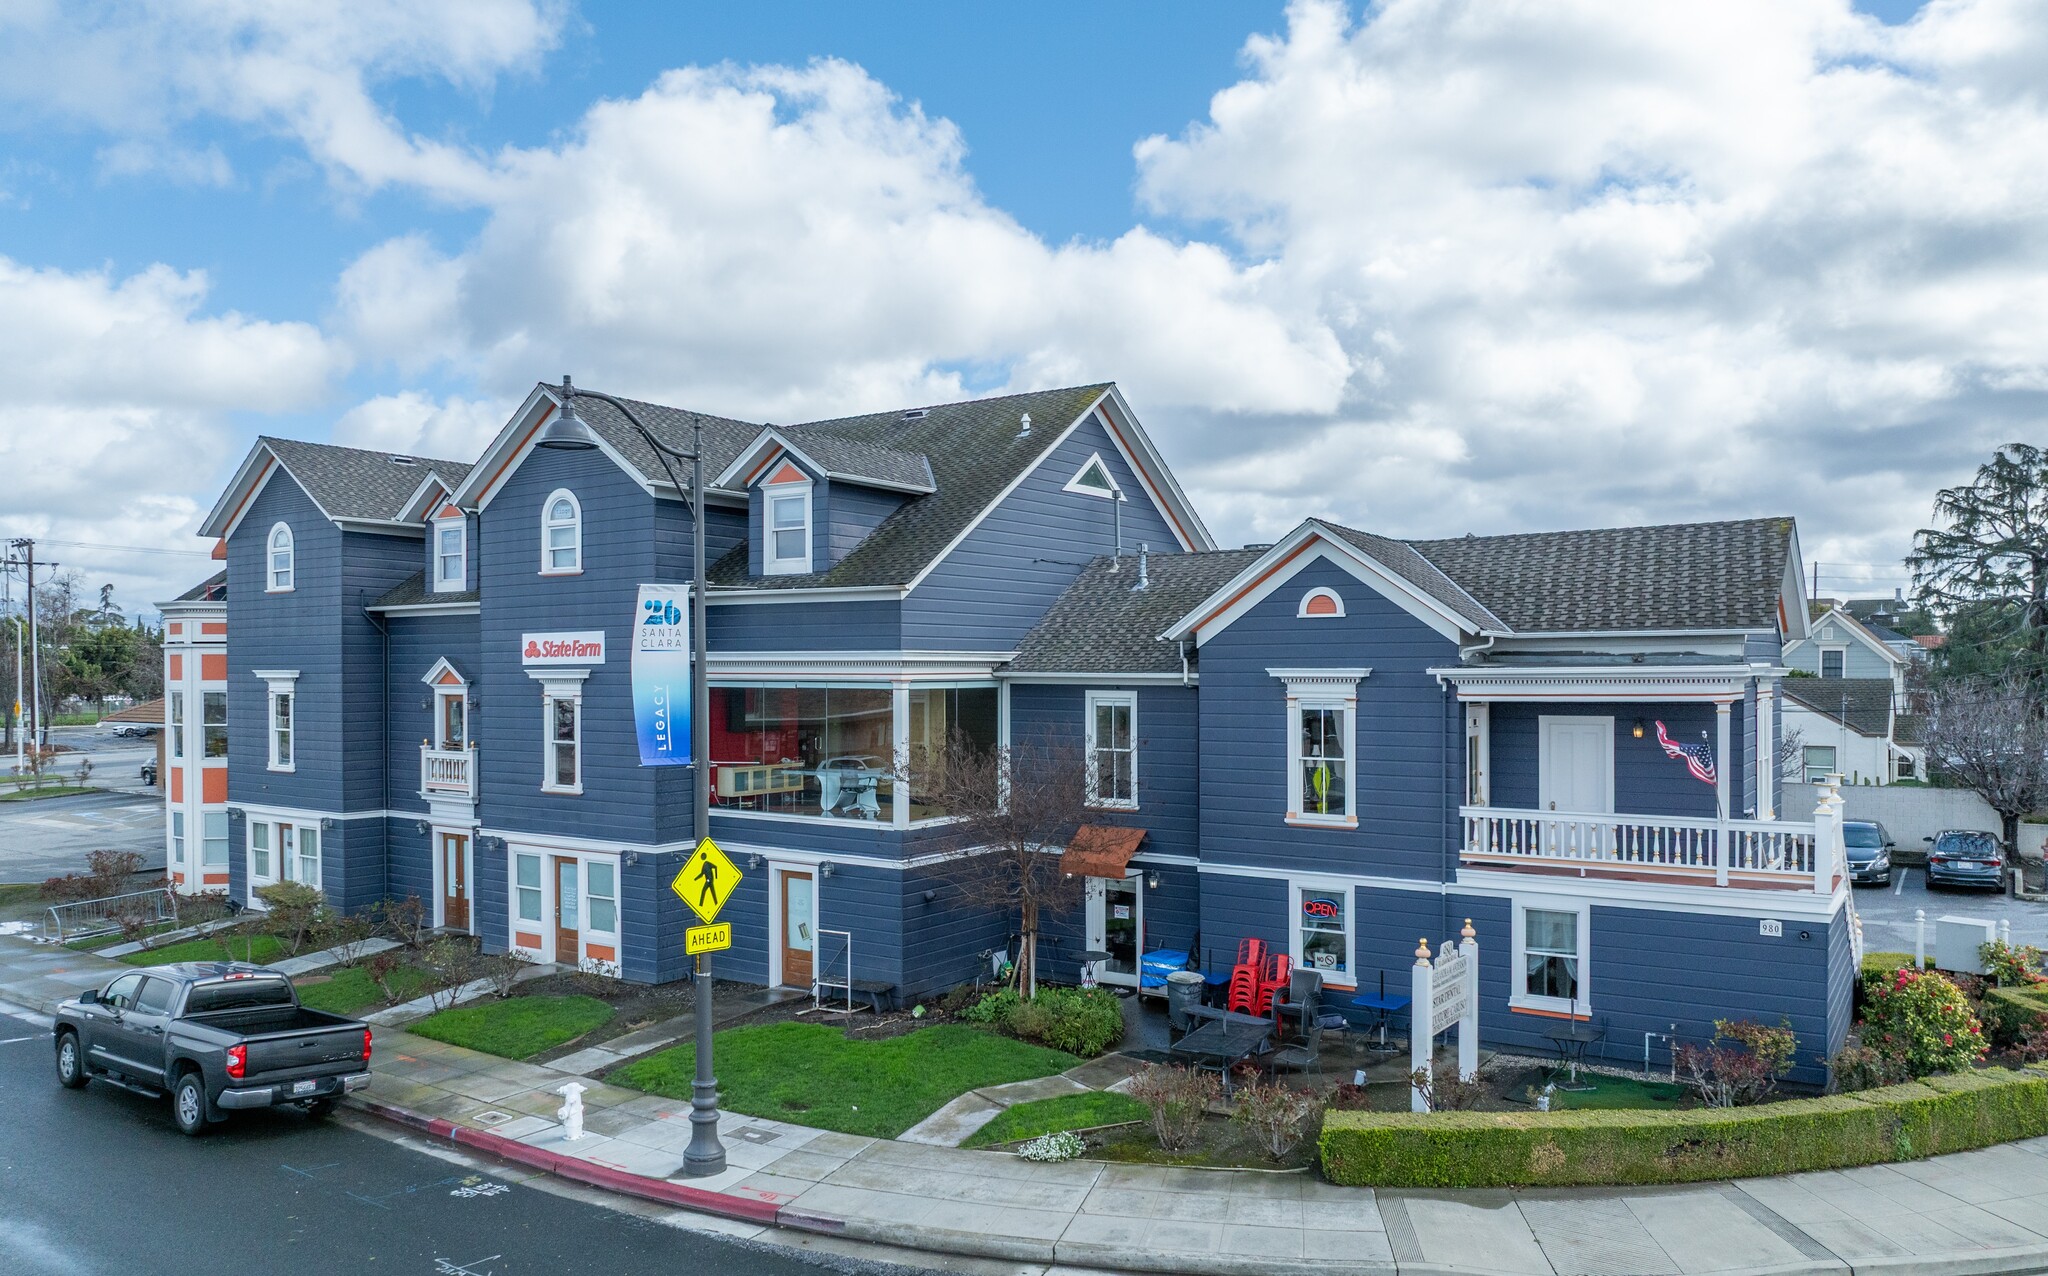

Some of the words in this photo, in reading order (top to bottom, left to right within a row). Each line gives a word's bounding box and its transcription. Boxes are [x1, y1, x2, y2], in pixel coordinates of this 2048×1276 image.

[643, 599, 682, 626] 26
[641, 628, 682, 637] SANTA
[640, 638, 682, 648] CLARA
[654, 685, 668, 751] LEGACY
[1303, 901, 1338, 918] OPEN
[1762, 924, 1779, 933] 980
[691, 930, 726, 947] AHEAD
